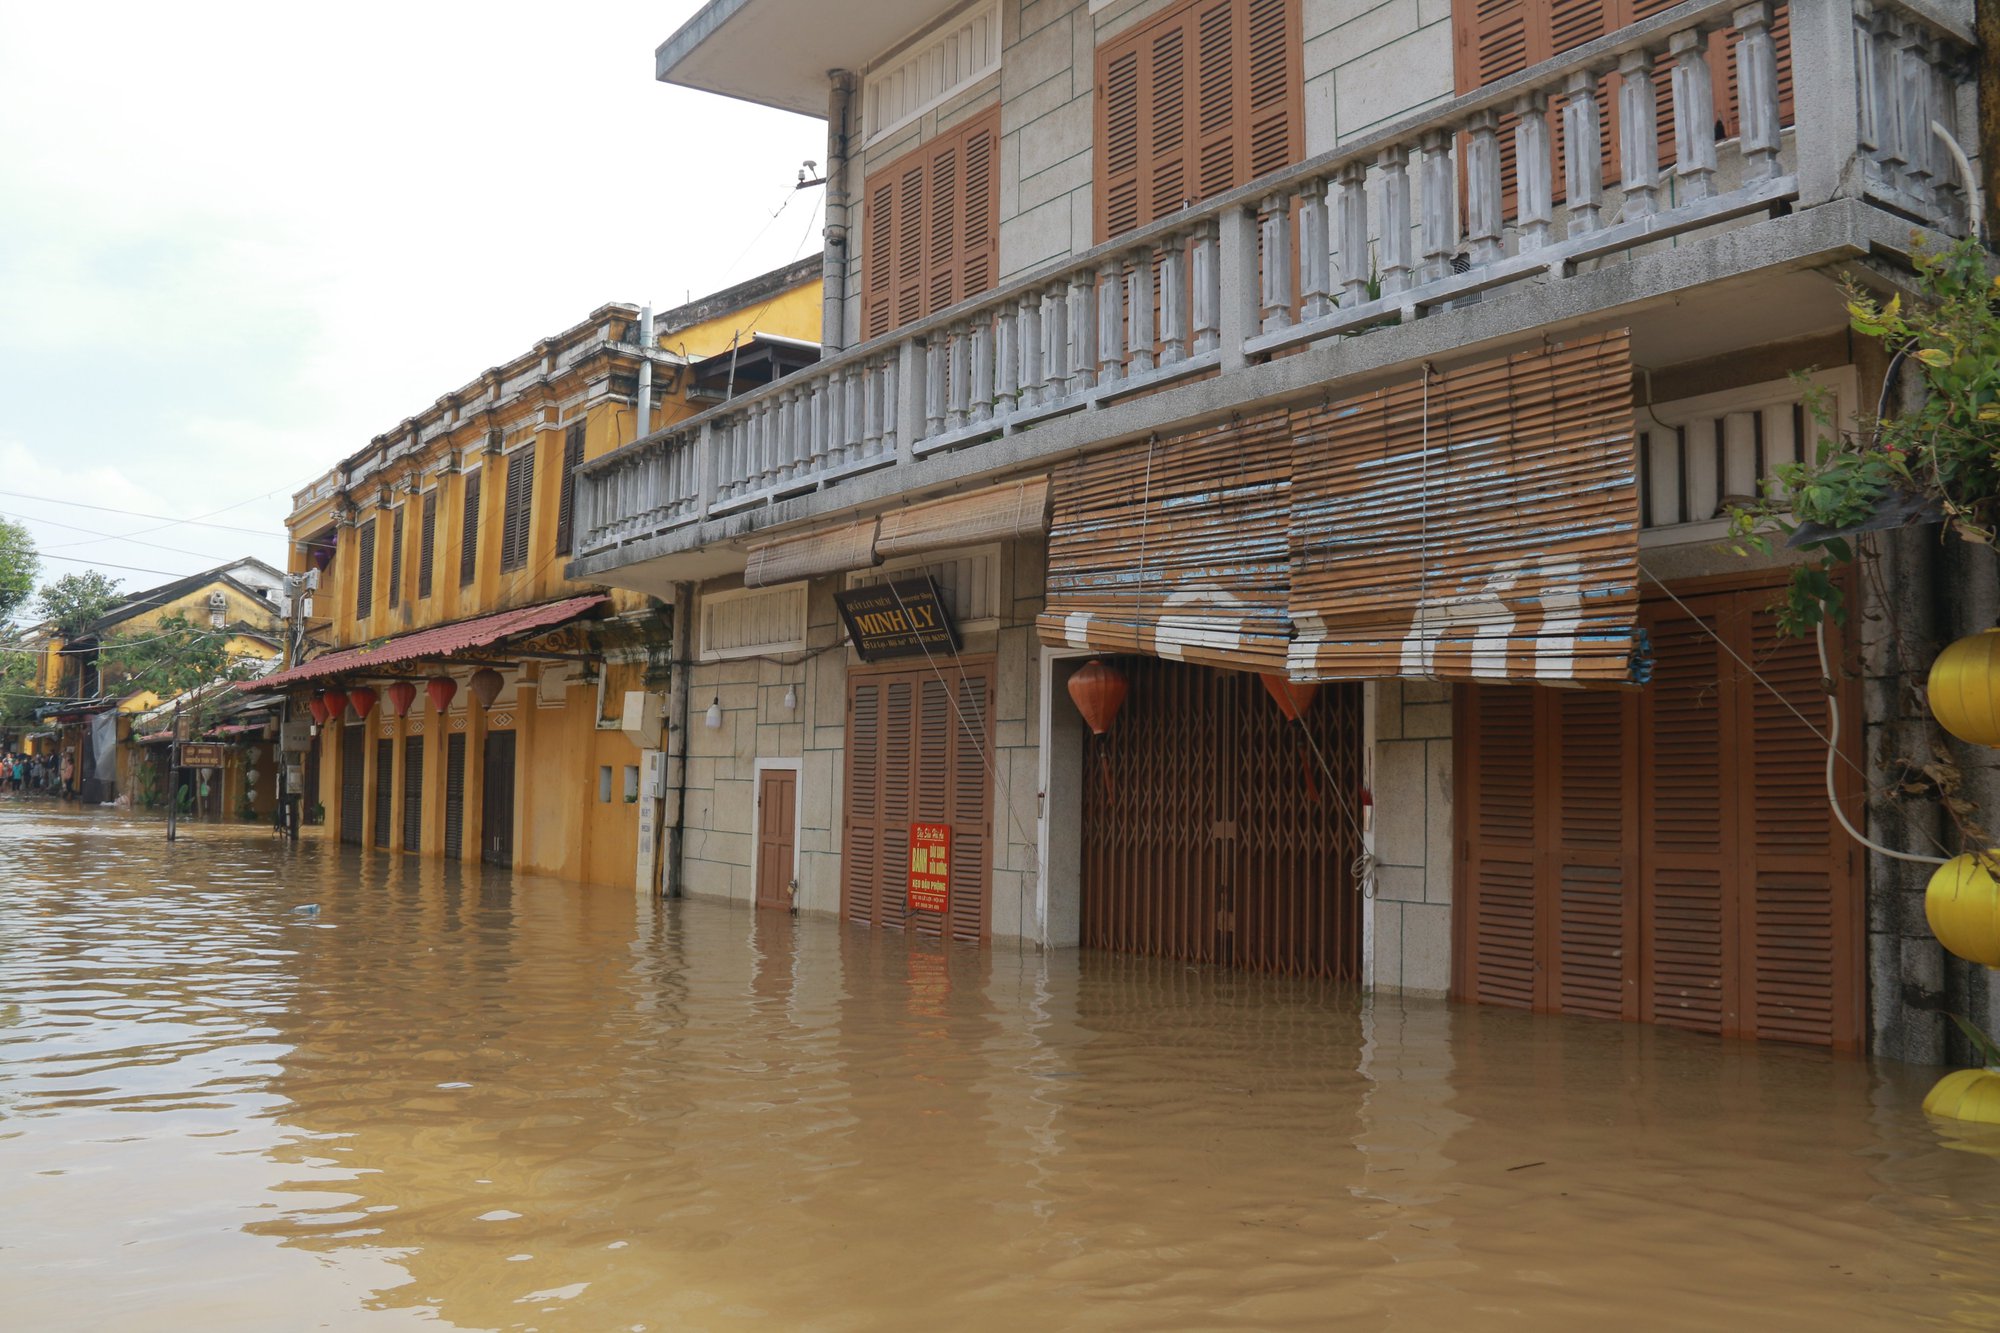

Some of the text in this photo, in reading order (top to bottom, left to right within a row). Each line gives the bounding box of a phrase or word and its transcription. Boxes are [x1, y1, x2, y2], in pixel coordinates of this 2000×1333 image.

[854, 604, 935, 636] MINH LY
[912, 842, 928, 873] BÁNH
